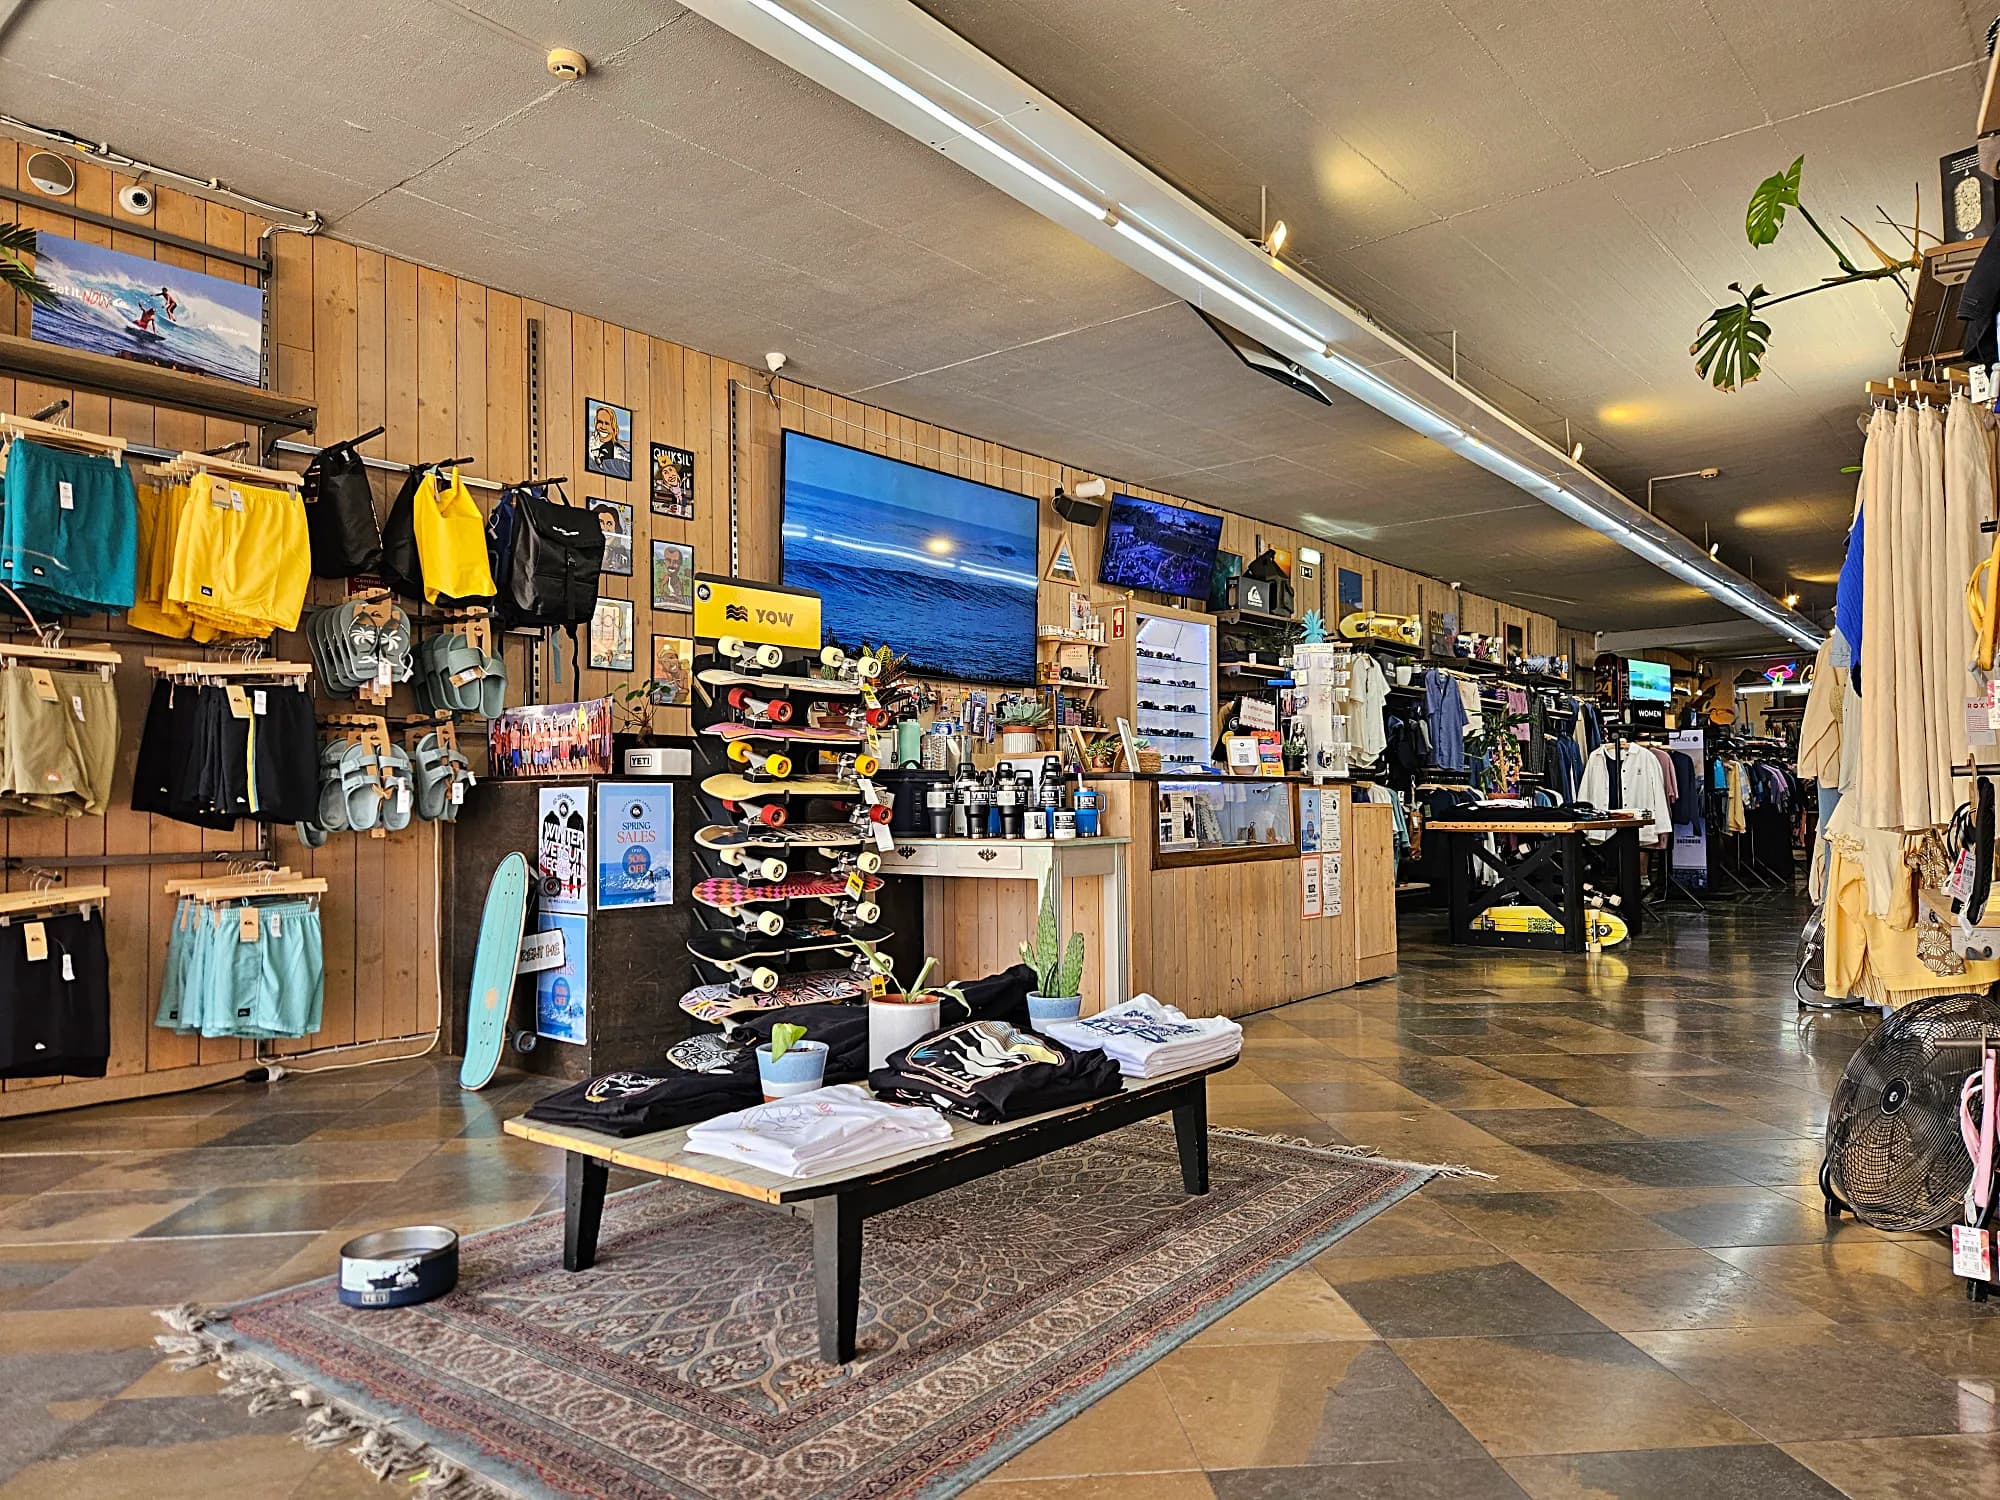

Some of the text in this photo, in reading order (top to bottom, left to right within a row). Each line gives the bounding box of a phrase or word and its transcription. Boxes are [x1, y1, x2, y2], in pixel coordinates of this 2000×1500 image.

[756, 608, 784, 628] YOW
[1638, 709, 1662, 718] WOMEN
[632, 756, 651, 766] YETI
[971, 791, 990, 799] YETI
[622, 822, 651, 831] SPRING
[544, 821, 585, 849] WINTER
[616, 831, 656, 843] SALES
